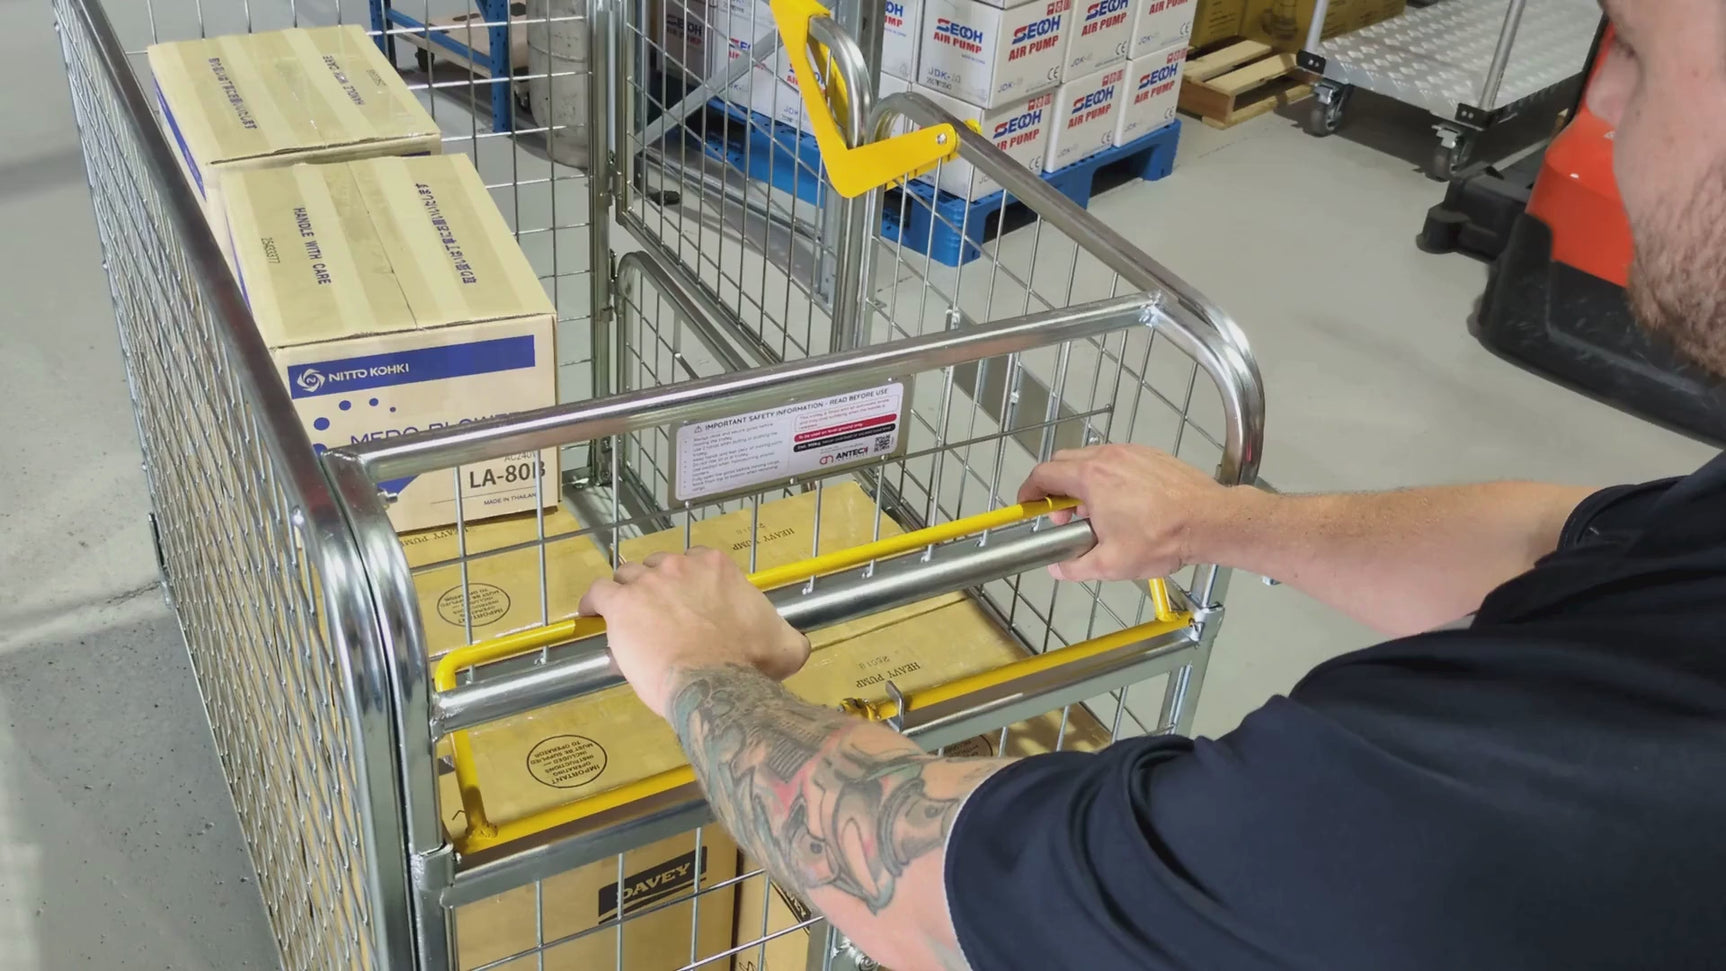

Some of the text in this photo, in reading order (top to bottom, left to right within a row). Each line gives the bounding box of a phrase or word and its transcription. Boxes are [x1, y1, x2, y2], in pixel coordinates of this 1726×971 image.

[1149, 2, 1164, 15] AIR
[1081, 13, 1127, 36] AIR PUMP
[934, 32, 982, 54] AIR PUMP
[1008, 35, 1059, 62] AIR PUMP
[1134, 80, 1175, 105] AIR PUMP
[1067, 103, 1112, 129] AIR PUMP
[1009, 128, 1040, 149] PUMP
[293, 207, 331, 285] HANDLE WITH CARE
[328, 363, 409, 382] NITTO KOHKI
[706, 417, 747, 430] IMPORTANT
[749, 410, 775, 422] SAFETY
[775, 403, 824, 416] INFORMATION
[829, 396, 848, 406] READ
[849, 390, 874, 401] BEFORE
[876, 388, 888, 396] USE
[483, 497, 501, 506] MADE
[503, 495, 510, 503] IN
[763, 528, 795, 542] HEAVY
[856, 662, 921, 688] HEAVY PUMP
[534, 744, 570, 758] OPERATOR
[553, 751, 587, 764] INCLUDED
[575, 743, 593, 752] MUST
[530, 752, 562, 765] SUPPLIED
[545, 755, 594, 773] INSTRUCTIONS
[553, 761, 591, 776] OPERATING
[552, 764, 600, 784] IMPORTANT
[617, 863, 690, 900] DAVEY
